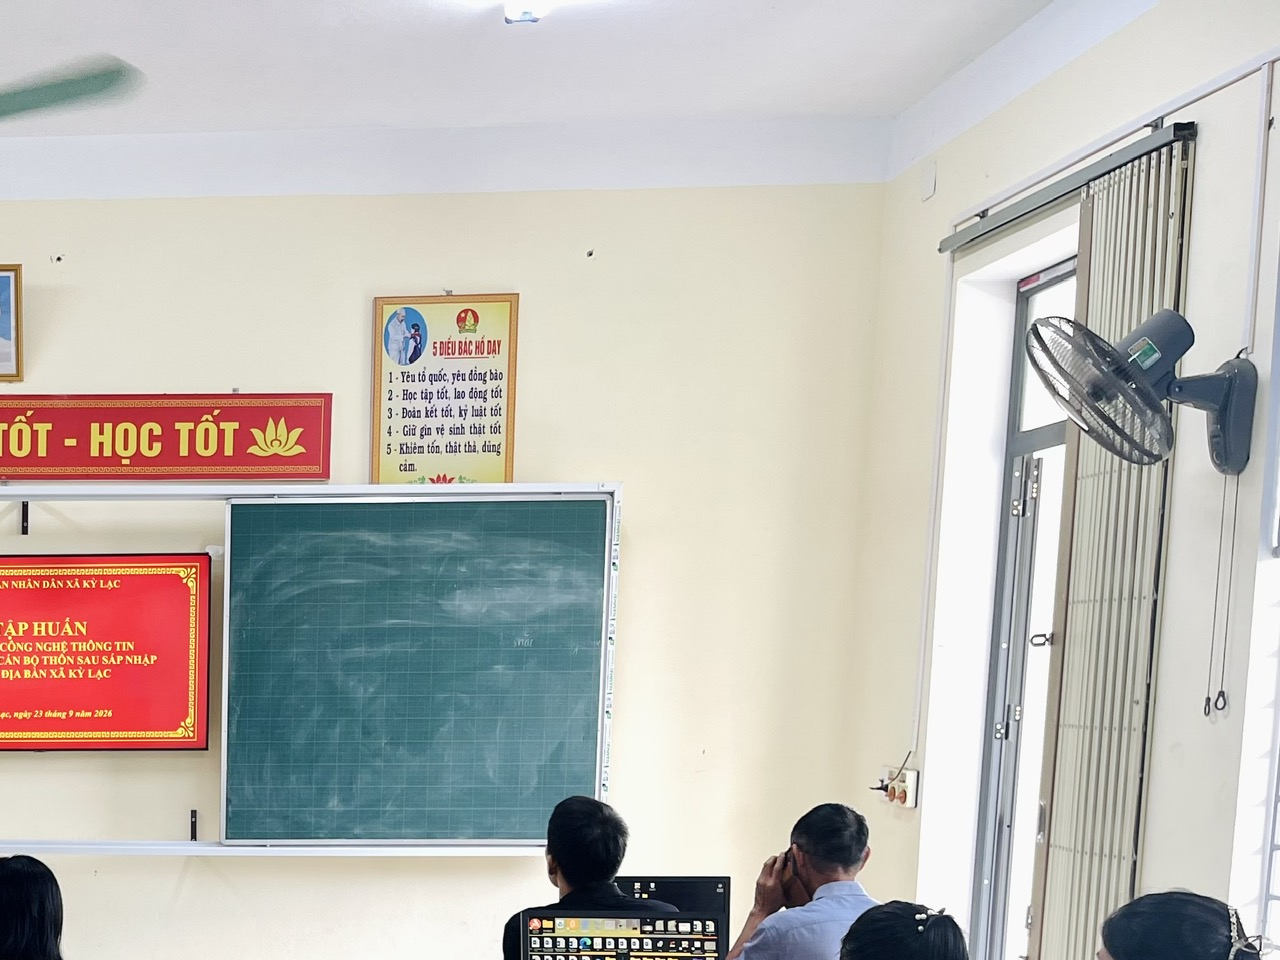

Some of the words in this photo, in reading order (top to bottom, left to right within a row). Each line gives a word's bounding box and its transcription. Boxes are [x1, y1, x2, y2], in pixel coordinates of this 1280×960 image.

[433, 342, 438, 356] 5
[439, 335, 456, 356] ĐIỀU
[458, 337, 472, 356] BÁC
[475, 335, 485, 355] HỒ
[488, 340, 502, 358] DẠY
[389, 372, 393, 383] 1
[401, 371, 415, 382] Yêu
[418, 367, 426, 382] tổ
[428, 368, 449, 385] quốc,
[452, 370, 466, 385] yêu
[469, 366, 487, 384] đồng
[490, 369, 504, 382] bào
[388, 390, 393, 400] 2
[402, 389, 417, 403] Học
[421, 389, 434, 403] tập
[437, 386, 450, 400] tốt,
[454, 388, 466, 400] lao
[469, 387, 487, 402] động
[491, 385, 502, 399] tốt
[388, 408, 392, 419] 3
[402, 406, 422, 418] Đoàn
[425, 404, 438, 418] kết
[441, 404, 455, 418] tốt,
[472, 405, 486, 419] luật
[490, 403, 502, 417] tốt
[64, 438, 77, 447] -
[90, 421, 162, 465] HỌC
[175, 410, 239, 457] TỐT
[387, 425, 392, 436] 4
[420, 424, 432, 439] gìn
[436, 424, 445, 438] vệ
[449, 424, 466, 435] sinh
[470, 423, 486, 437] thật
[490, 421, 502, 434] tốt
[386, 444, 392, 454] 5
[399, 442, 424, 454] Khiêm
[428, 439, 442, 456] tốn,
[446, 441, 461, 456] thật
[11, 578, 40, 589] NHÂN
[42, 578, 64, 589] DÂN
[66, 578, 81, 589] XÃ
[100, 580, 121, 590] LẠC
[32, 617, 88, 637] HUẤN
[0, 639, 34, 652] CÔNG
[35, 641, 68, 654] NGHỆ
[70, 640, 112, 652] THÔNG
[115, 642, 135, 651] TIN
[23, 654, 40, 668] BỘ
[42, 653, 74, 666] THÔN
[76, 656, 100, 666] SAU
[102, 654, 124, 665] SÁP
[125, 654, 158, 666] NHẬP
[0, 670, 22, 680] ĐỊA
[23, 668, 48, 679] BÀN
[50, 668, 66, 679] XÃ
[88, 669, 112, 680] LẠC
[13, 710, 32, 720] ngày
[34, 710, 43, 718] 23
[44, 710, 67, 720] tháng
[68, 710, 74, 718] 9
[75, 710, 92, 718] năm
